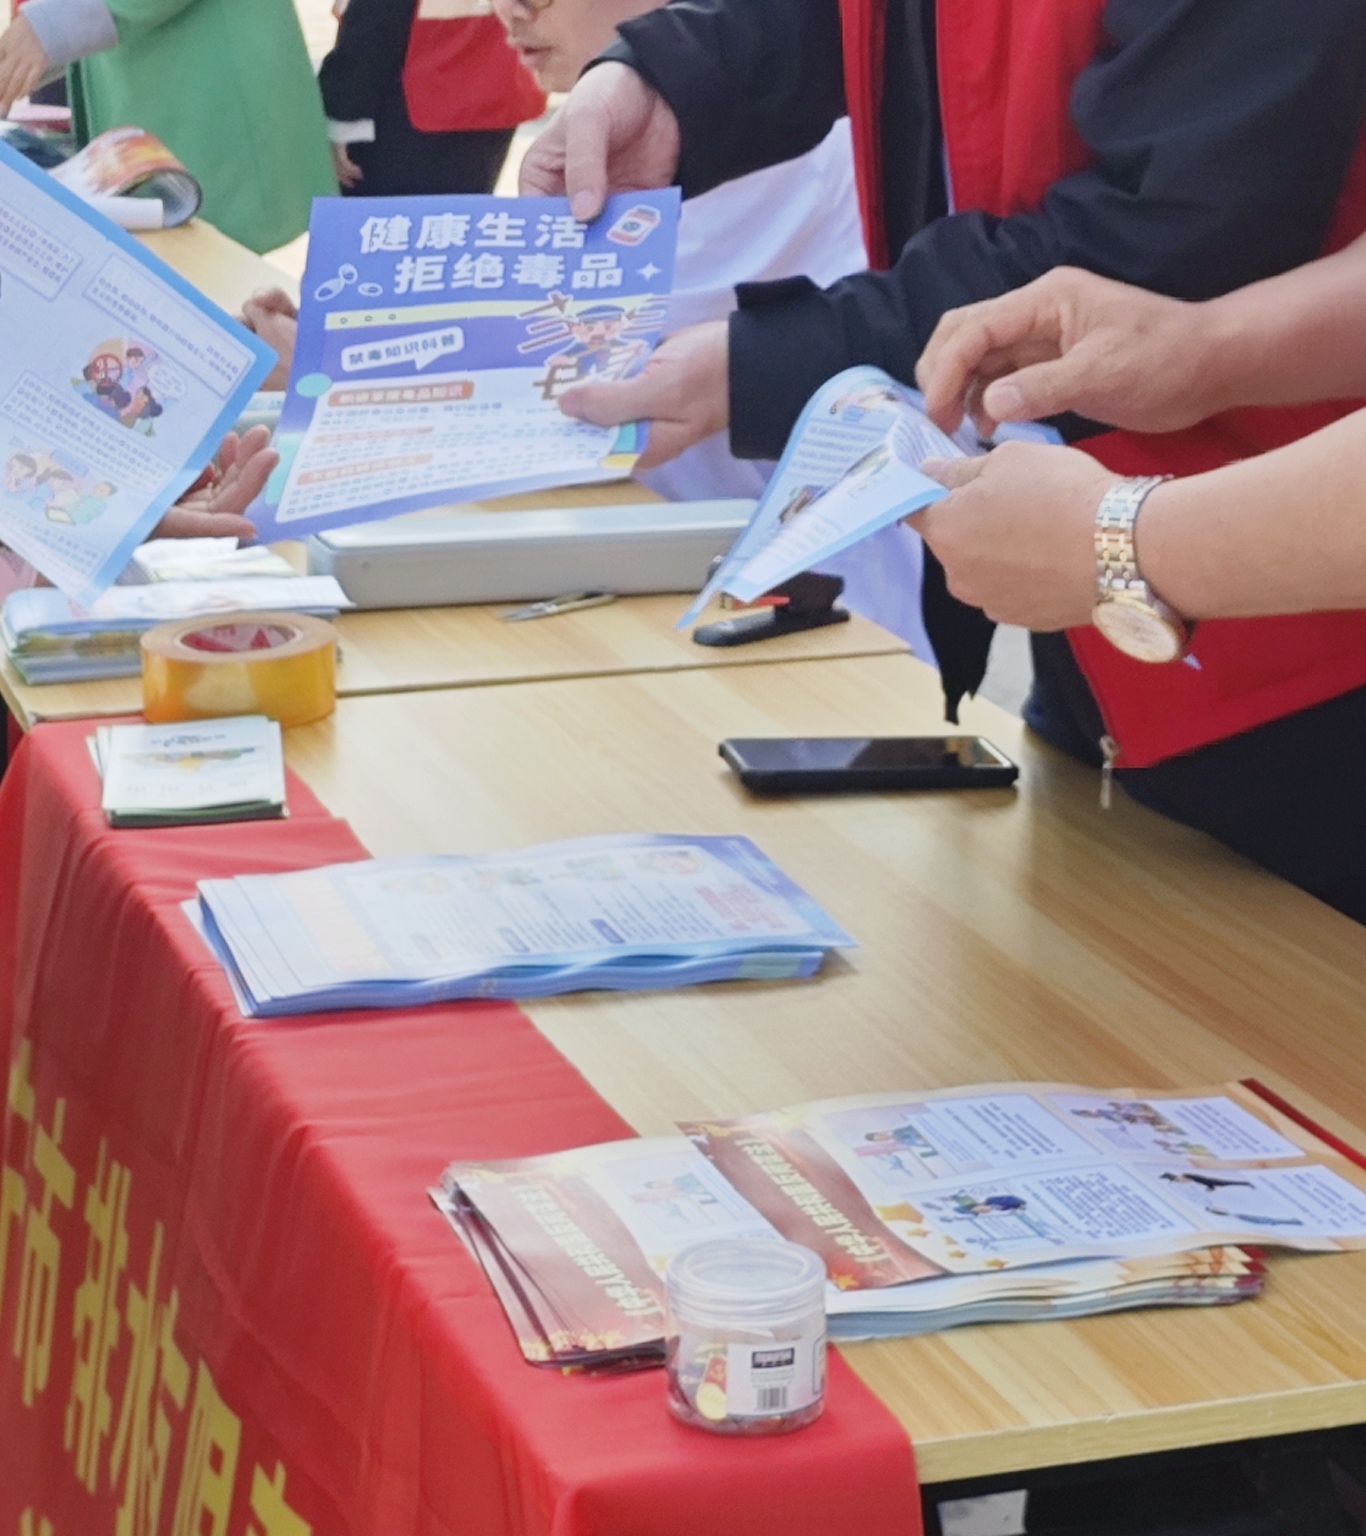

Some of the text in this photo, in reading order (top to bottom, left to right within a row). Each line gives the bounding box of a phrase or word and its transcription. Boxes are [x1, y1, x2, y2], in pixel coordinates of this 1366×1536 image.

[359, 212, 588, 254] 健康生活
[392, 252, 624, 295] 拒绝毒品
